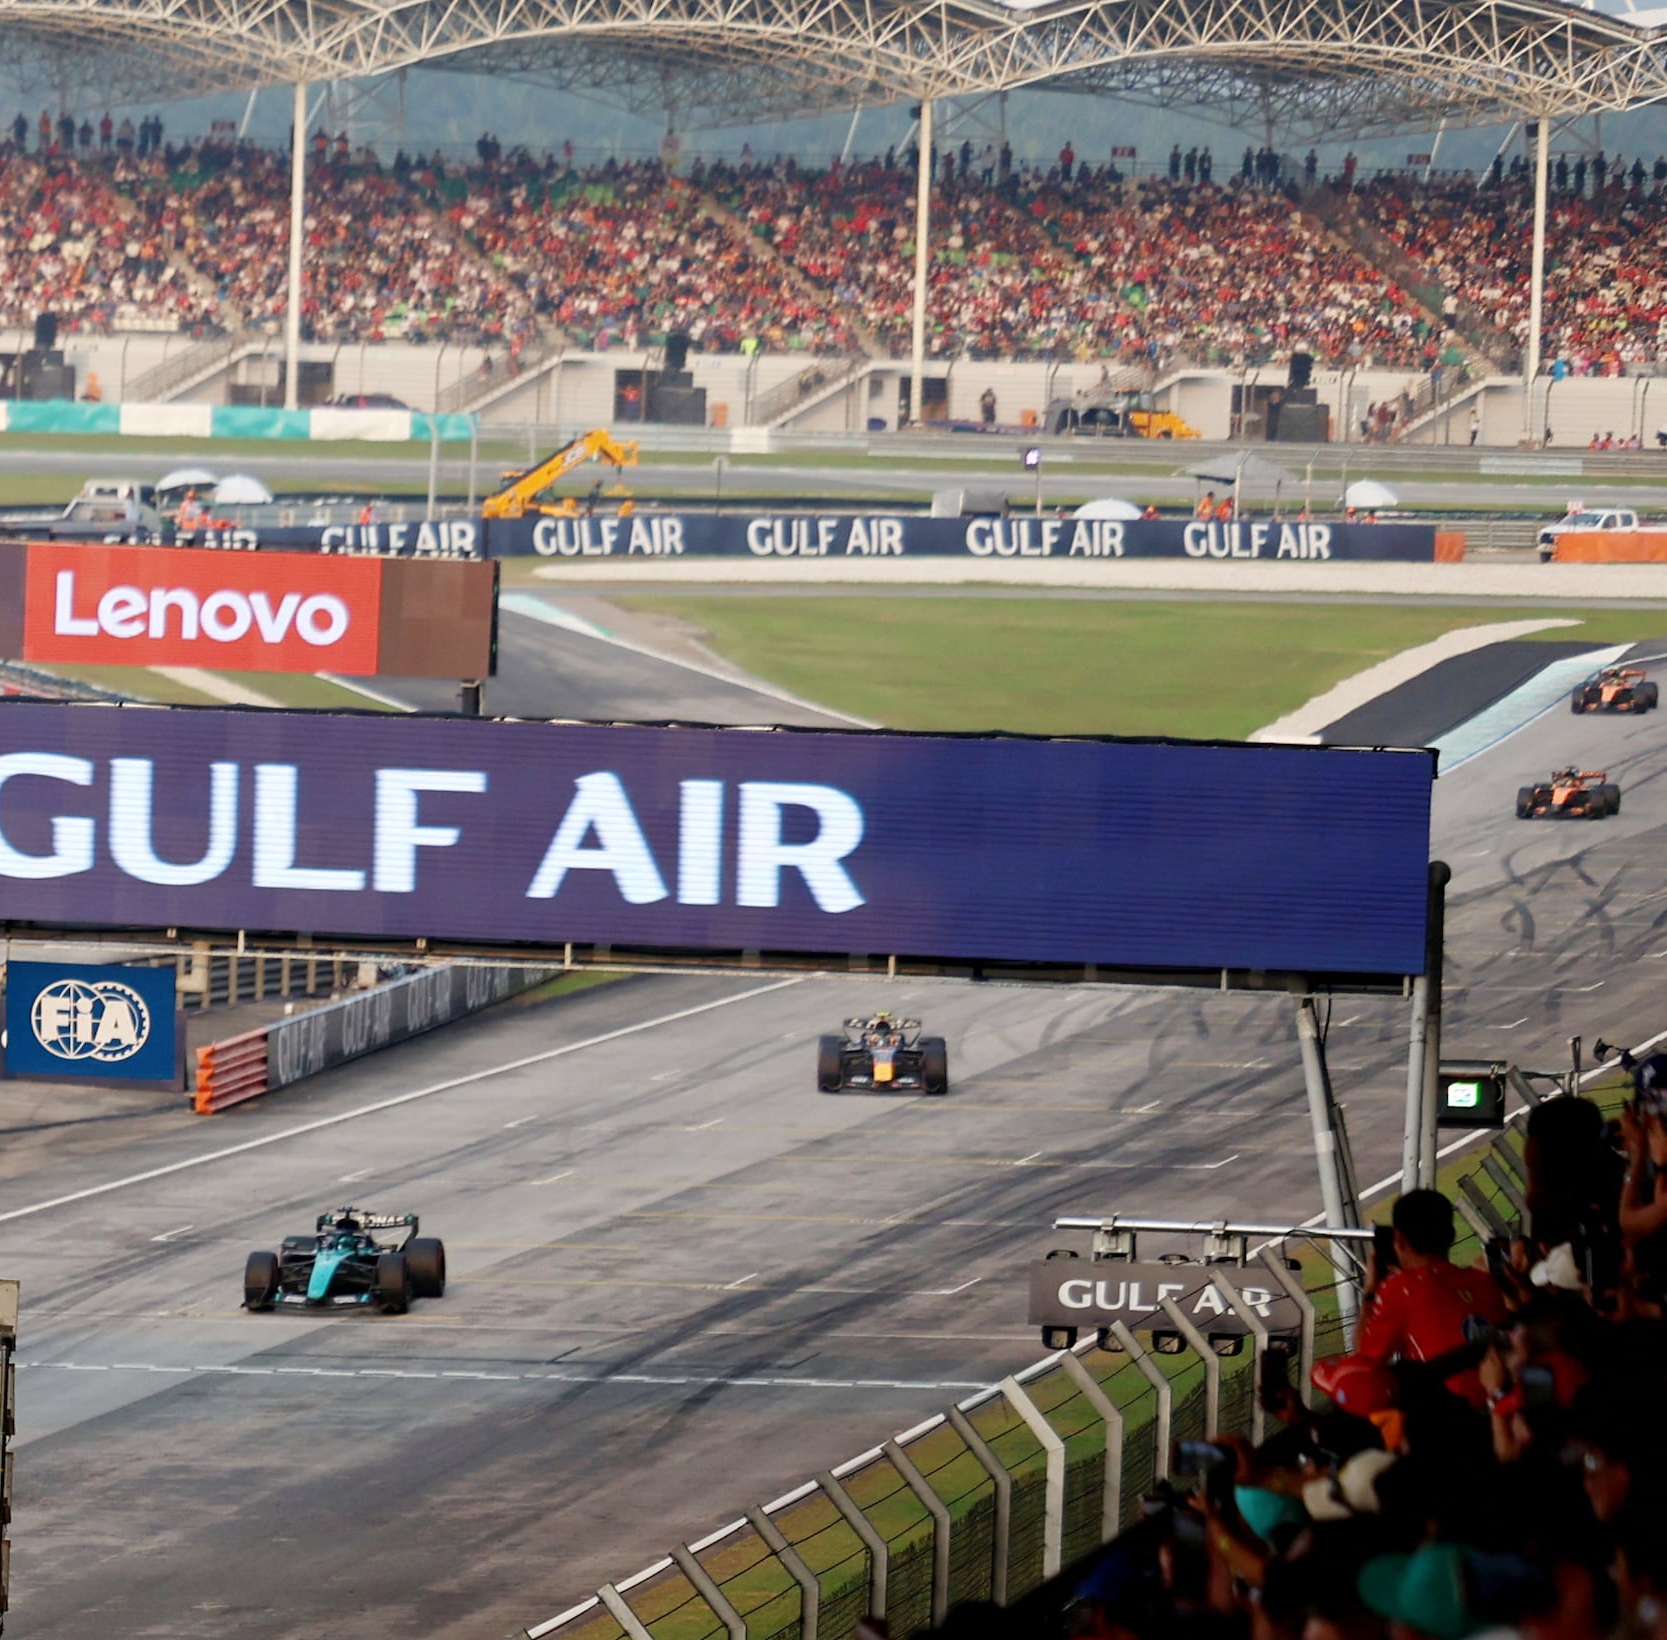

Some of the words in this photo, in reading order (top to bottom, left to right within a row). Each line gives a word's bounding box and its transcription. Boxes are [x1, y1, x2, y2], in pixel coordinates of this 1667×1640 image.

[533, 516, 620, 555] GULF
[628, 516, 685, 555] AIR
[748, 518, 838, 557] GULF
[847, 516, 905, 556] AIR
[966, 518, 1061, 558] GULF
[1071, 519, 1126, 558] AIR
[1184, 521, 1269, 559] GULF
[1276, 521, 1332, 561] AIR
[55, 570, 350, 646] Lenovo
[526, 772, 867, 914] AIR
[1057, 1279, 1184, 1311] GULF
[1192, 1286, 1271, 1318] AR
